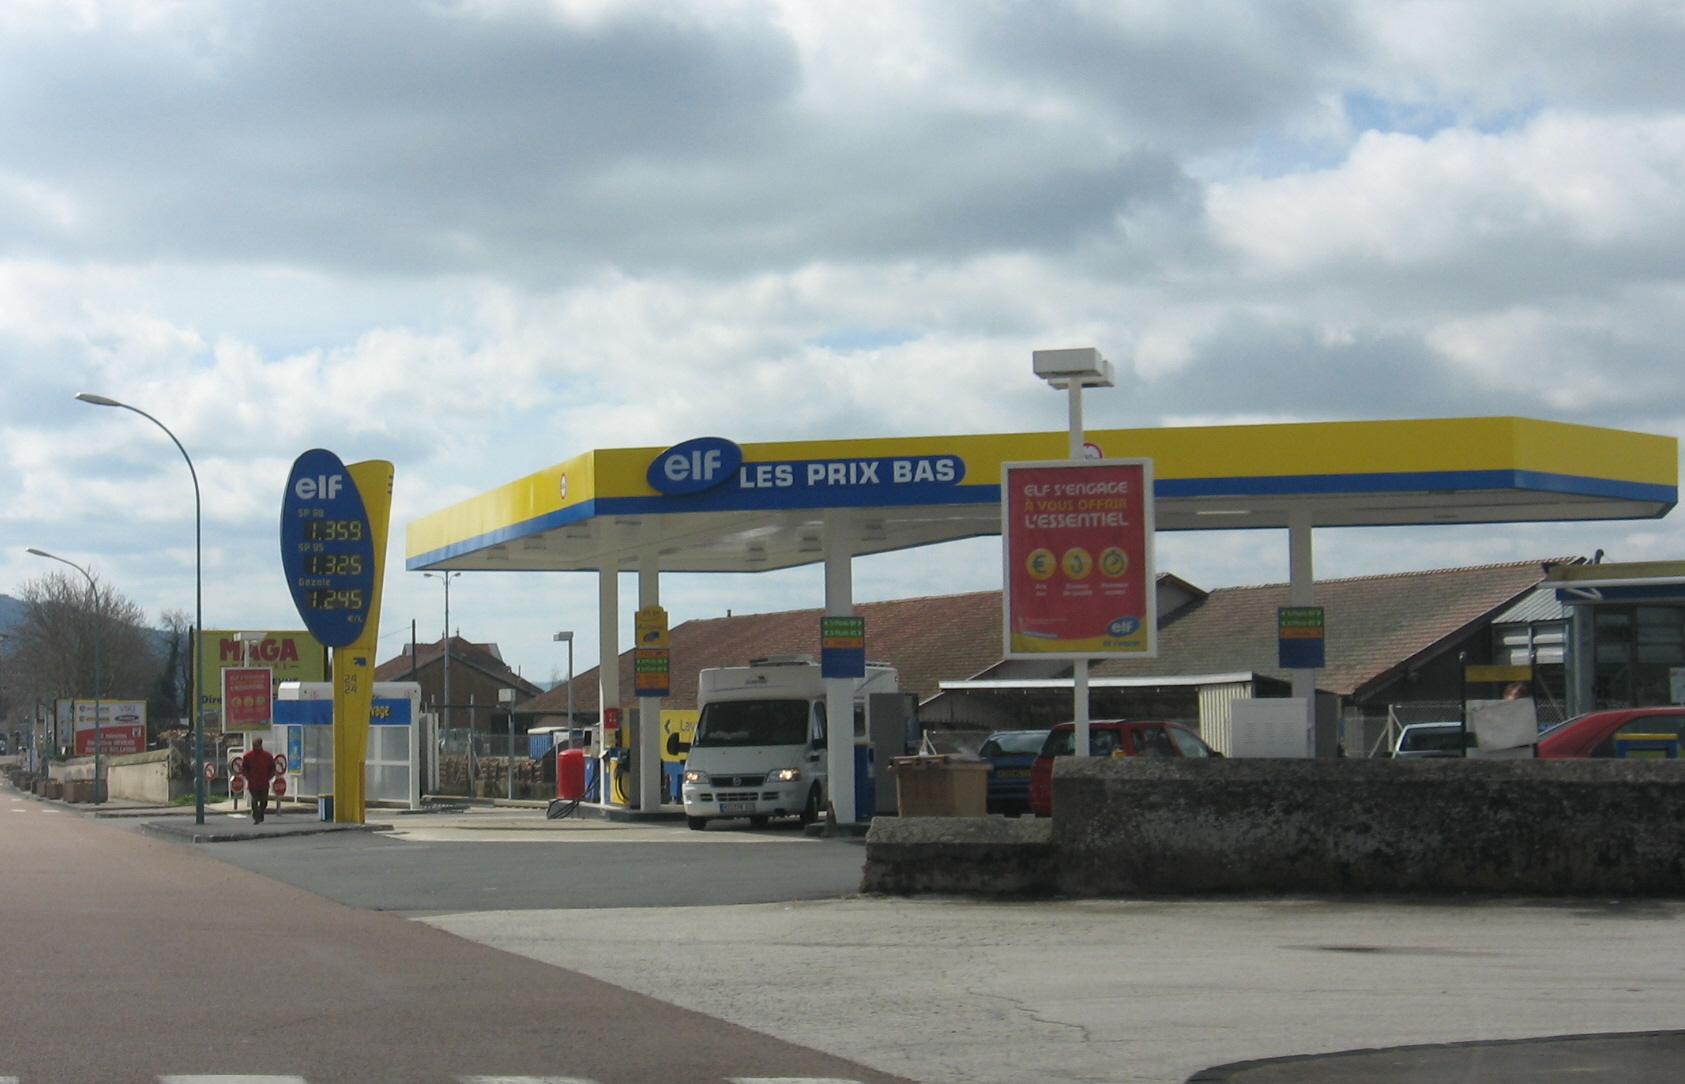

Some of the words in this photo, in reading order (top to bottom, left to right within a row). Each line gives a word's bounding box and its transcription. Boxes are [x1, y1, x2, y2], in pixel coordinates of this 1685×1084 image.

[664, 448, 722, 481] elf
[739, 463, 794, 488] LES
[807, 461, 881, 486] PRIX
[893, 458, 956, 485] BAS
[295, 475, 343, 500] elf
[1024, 484, 1051, 497] ELF
[1054, 482, 1128, 496] S'ENGAGE
[1037, 499, 1074, 512] VOUS
[298, 508, 310, 518] SP
[1025, 512, 1129, 528] L'ESSENTIEL
[312, 520, 362, 541] 1.359
[298, 543, 310, 552] SP
[312, 555, 362, 575] 1.325
[298, 578, 331, 586] Gazole
[312, 589, 362, 610] 1.245
[1112, 620, 1133, 633] elf
[220, 638, 299, 661] MAGA
[344, 674, 357, 683] 24
[344, 685, 357, 694] 24
[371, 706, 390, 719] vage
[680, 719, 697, 732] Lav
